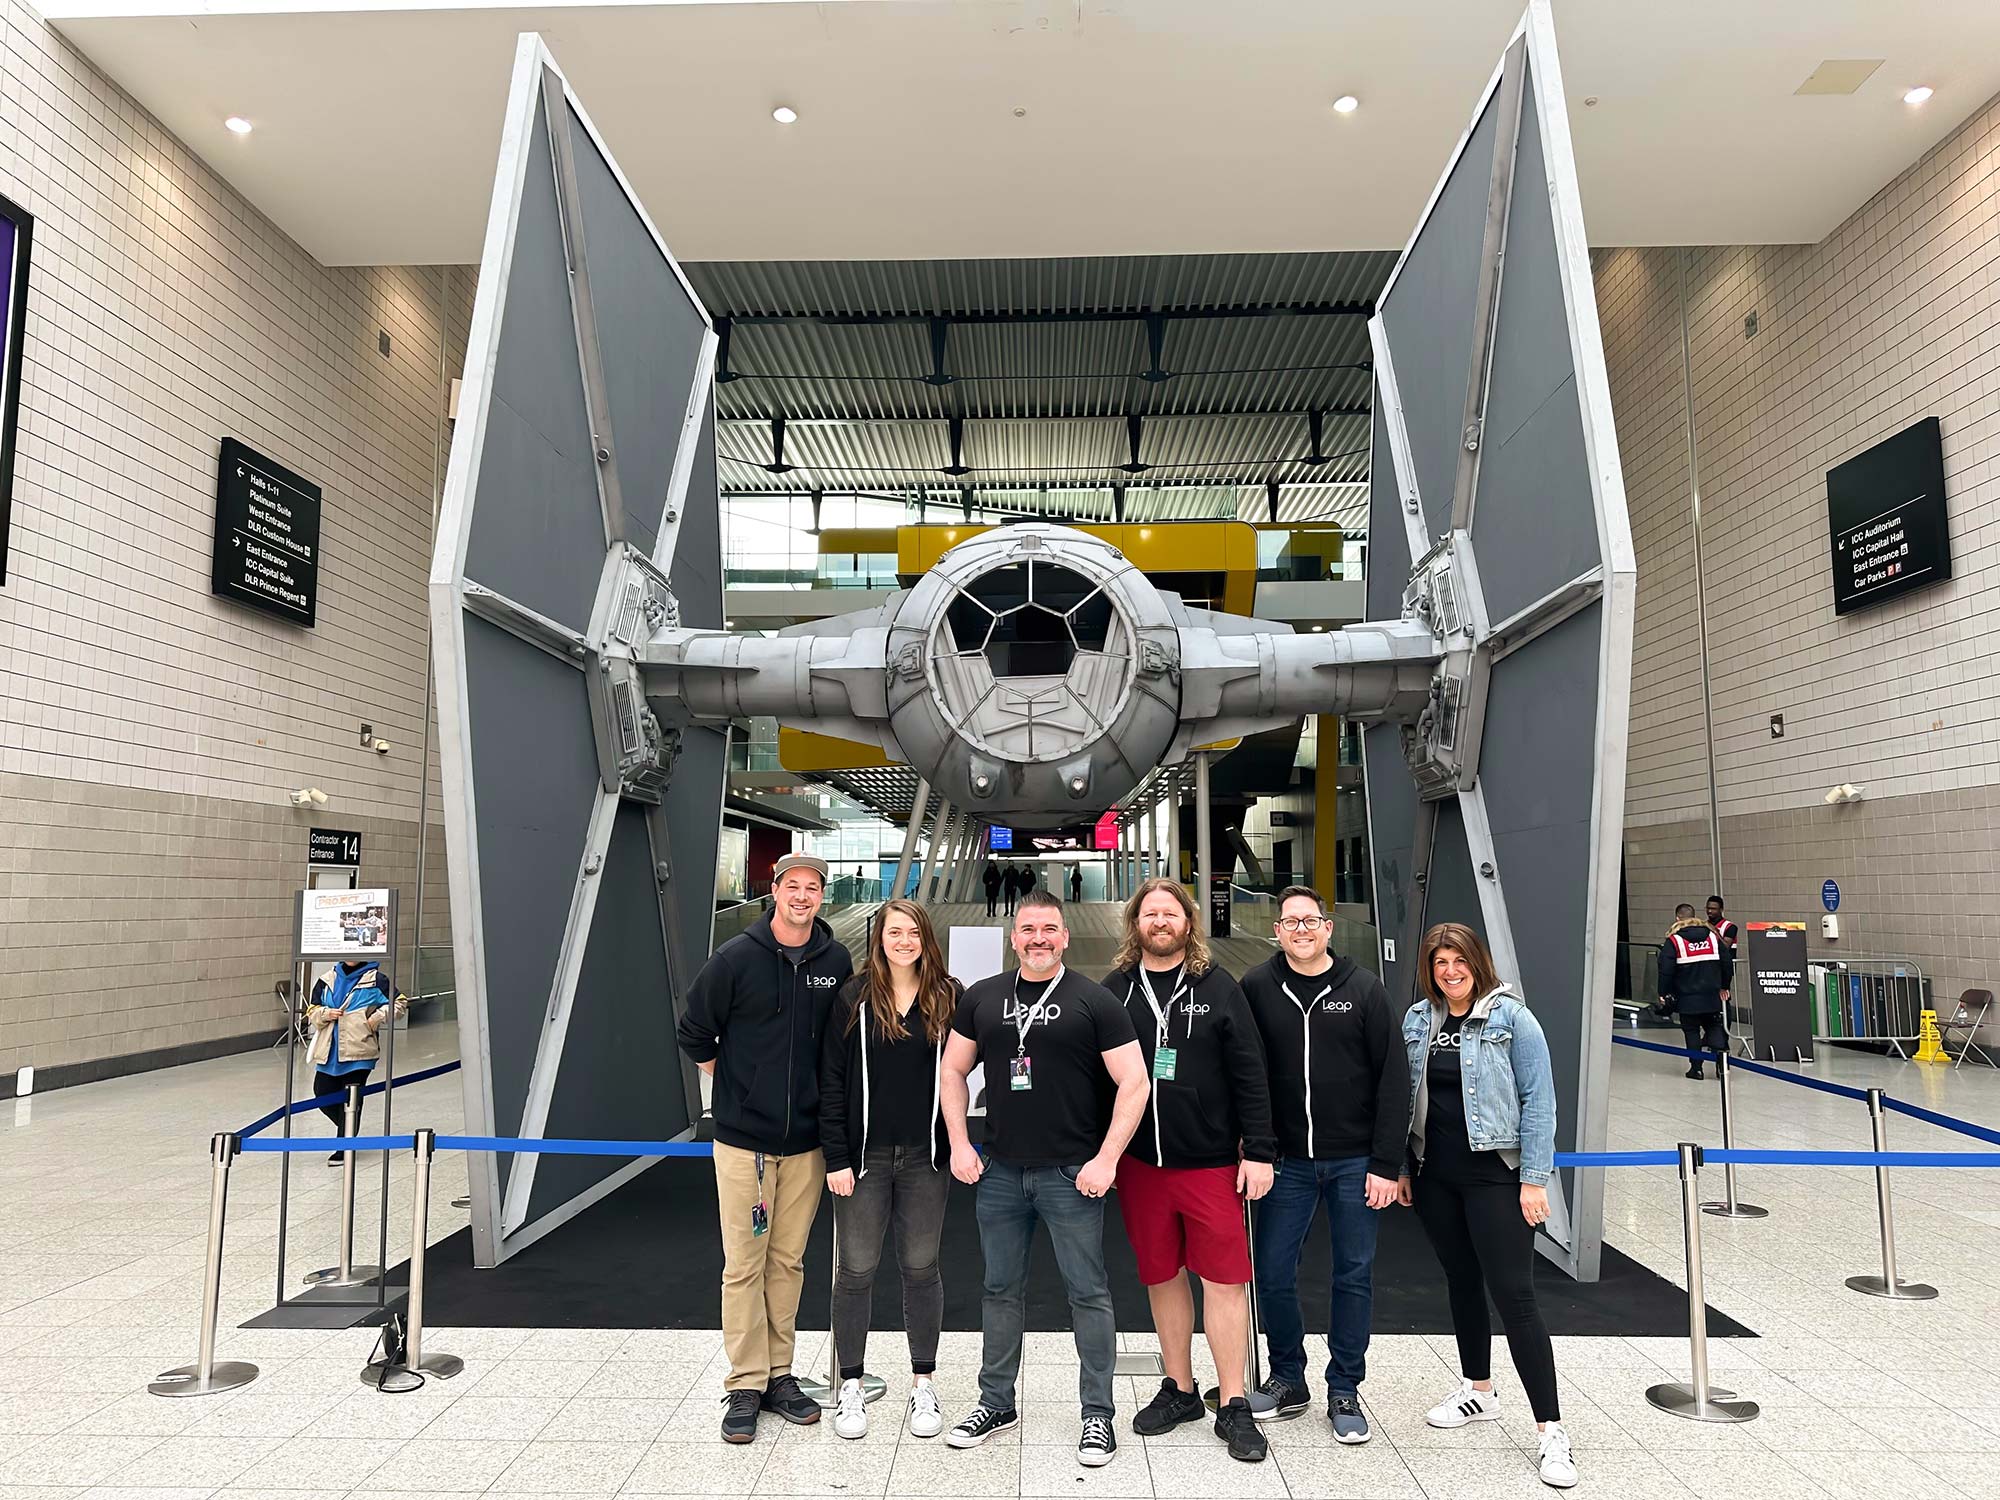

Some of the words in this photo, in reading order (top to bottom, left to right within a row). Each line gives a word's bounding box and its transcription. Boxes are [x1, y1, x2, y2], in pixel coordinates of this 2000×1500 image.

[250, 474, 266, 489] Halls
[267, 483, 279, 496] 1-11
[249, 489, 276, 510] Platinum
[277, 503, 292, 518] Suite
[249, 504, 264, 519] West
[265, 512, 291, 532] Entrance
[248, 519, 261, 534] DLR
[262, 527, 285, 545] Custom
[286, 537, 303, 553] House
[1851, 532, 1864, 544] ICC
[1865, 517, 1901, 539] Auditorium
[247, 542, 261, 556] East
[261, 549, 288, 568] Entrance
[1852, 547, 1865, 559] ICC
[1866, 536, 1889, 554] Capital
[1890, 530, 1904, 542] Hall
[245, 557, 257, 570] ICC
[258, 563, 279, 579] Capital
[280, 572, 294, 586] Suite
[1853, 561, 1868, 573] East
[1869, 549, 1899, 567] Entrance
[244, 573, 258, 586] DLR
[259, 578, 279, 595] Prince
[279, 587, 299, 602] Regent
[1854, 577, 1866, 588] Car
[1867, 570, 1887, 584] Parks
[311, 833, 339, 845] Contractor
[342, 836, 358, 860] 14
[310, 848, 335, 859] Entrance
[1688, 941, 1710, 951] S222
[806, 974, 837, 988] Leap
[1003, 998, 1061, 1025] Leap
[1180, 1002, 1210, 1016] Leap
[1322, 999, 1353, 1013] Leap
